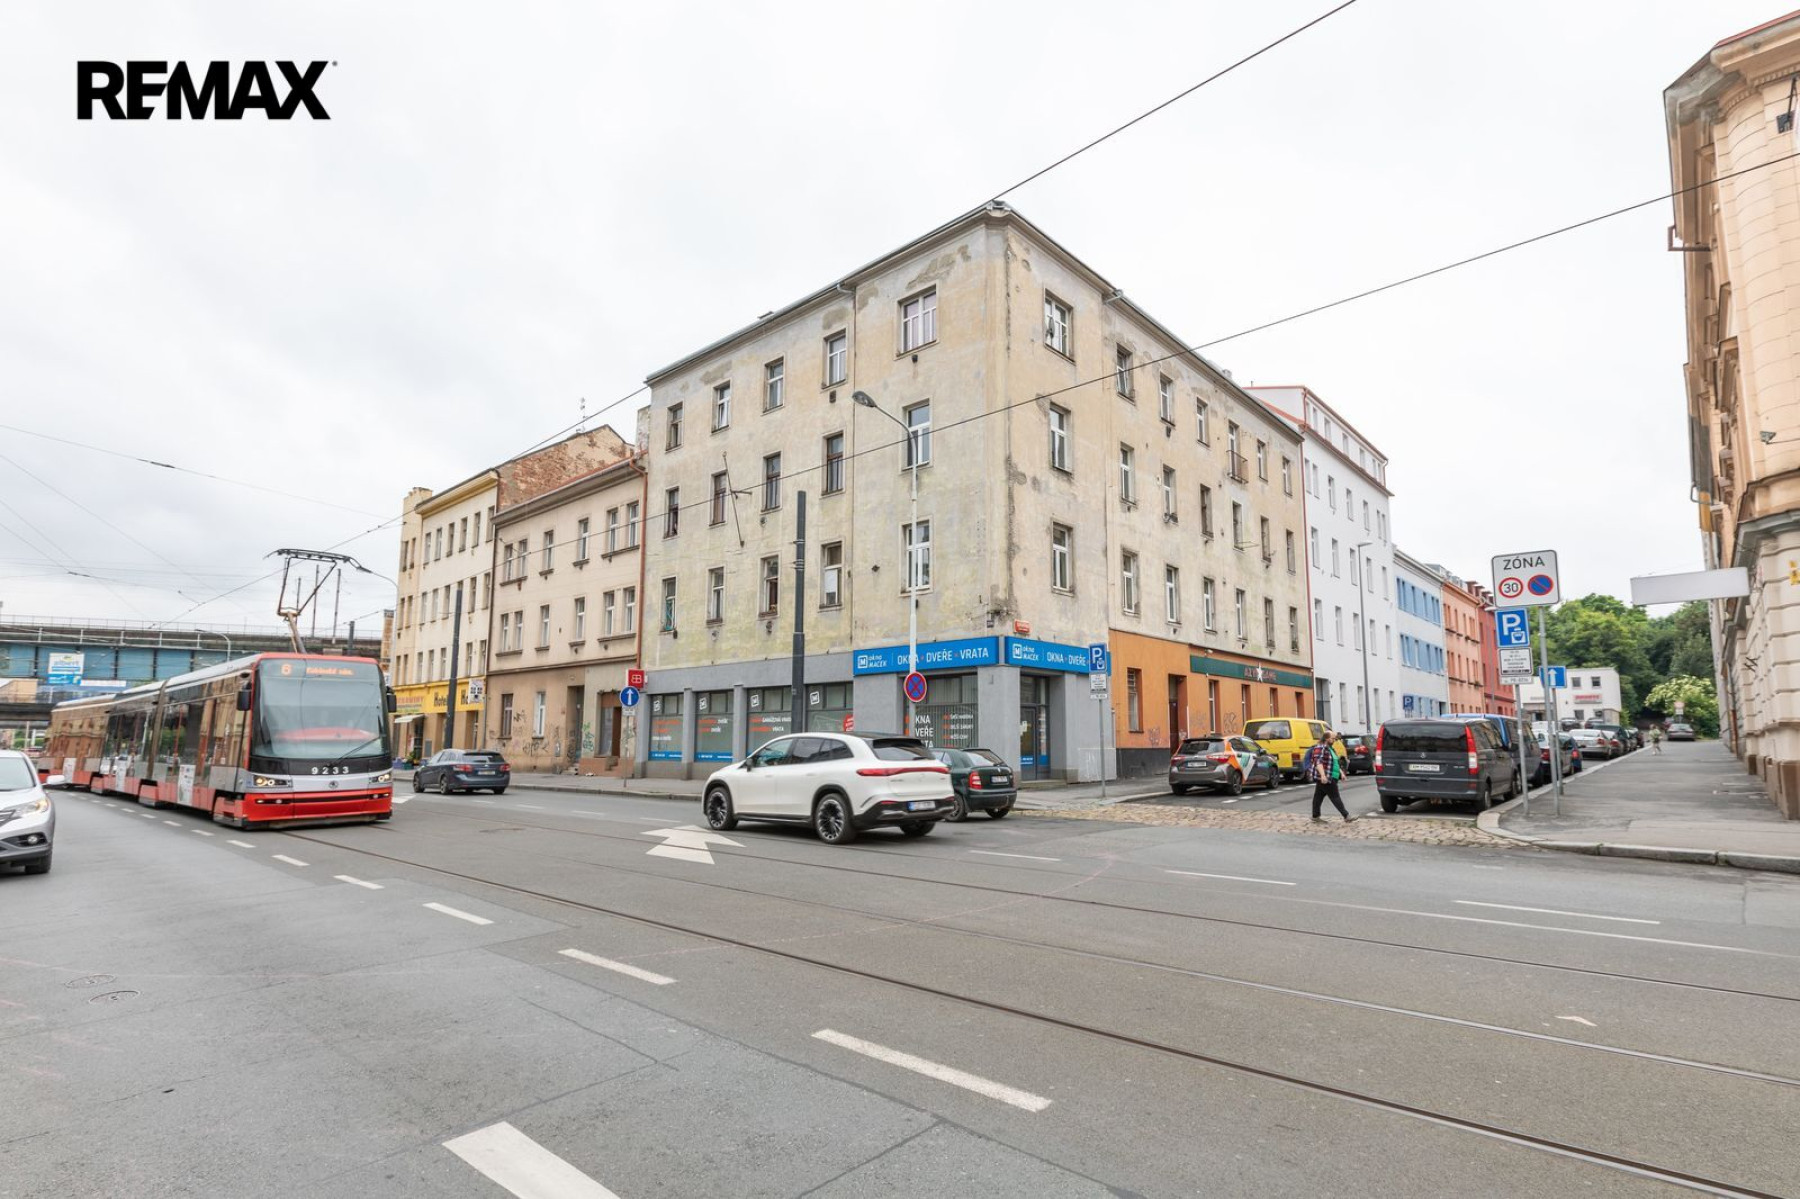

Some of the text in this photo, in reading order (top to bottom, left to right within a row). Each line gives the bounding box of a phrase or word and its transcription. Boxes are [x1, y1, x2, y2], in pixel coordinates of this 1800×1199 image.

[1503, 556, 1545, 570] ZÓNA
[1503, 583, 1518, 593] 30
[1502, 614, 1521, 635] P
[897, 647, 989, 665] OKA DVEŘE VRATA
[1046, 651, 1064, 664] OKNA
[1091, 647, 1102, 664] P
[915, 725, 934, 737] VEŘE
[311, 766, 349, 775] 9233
